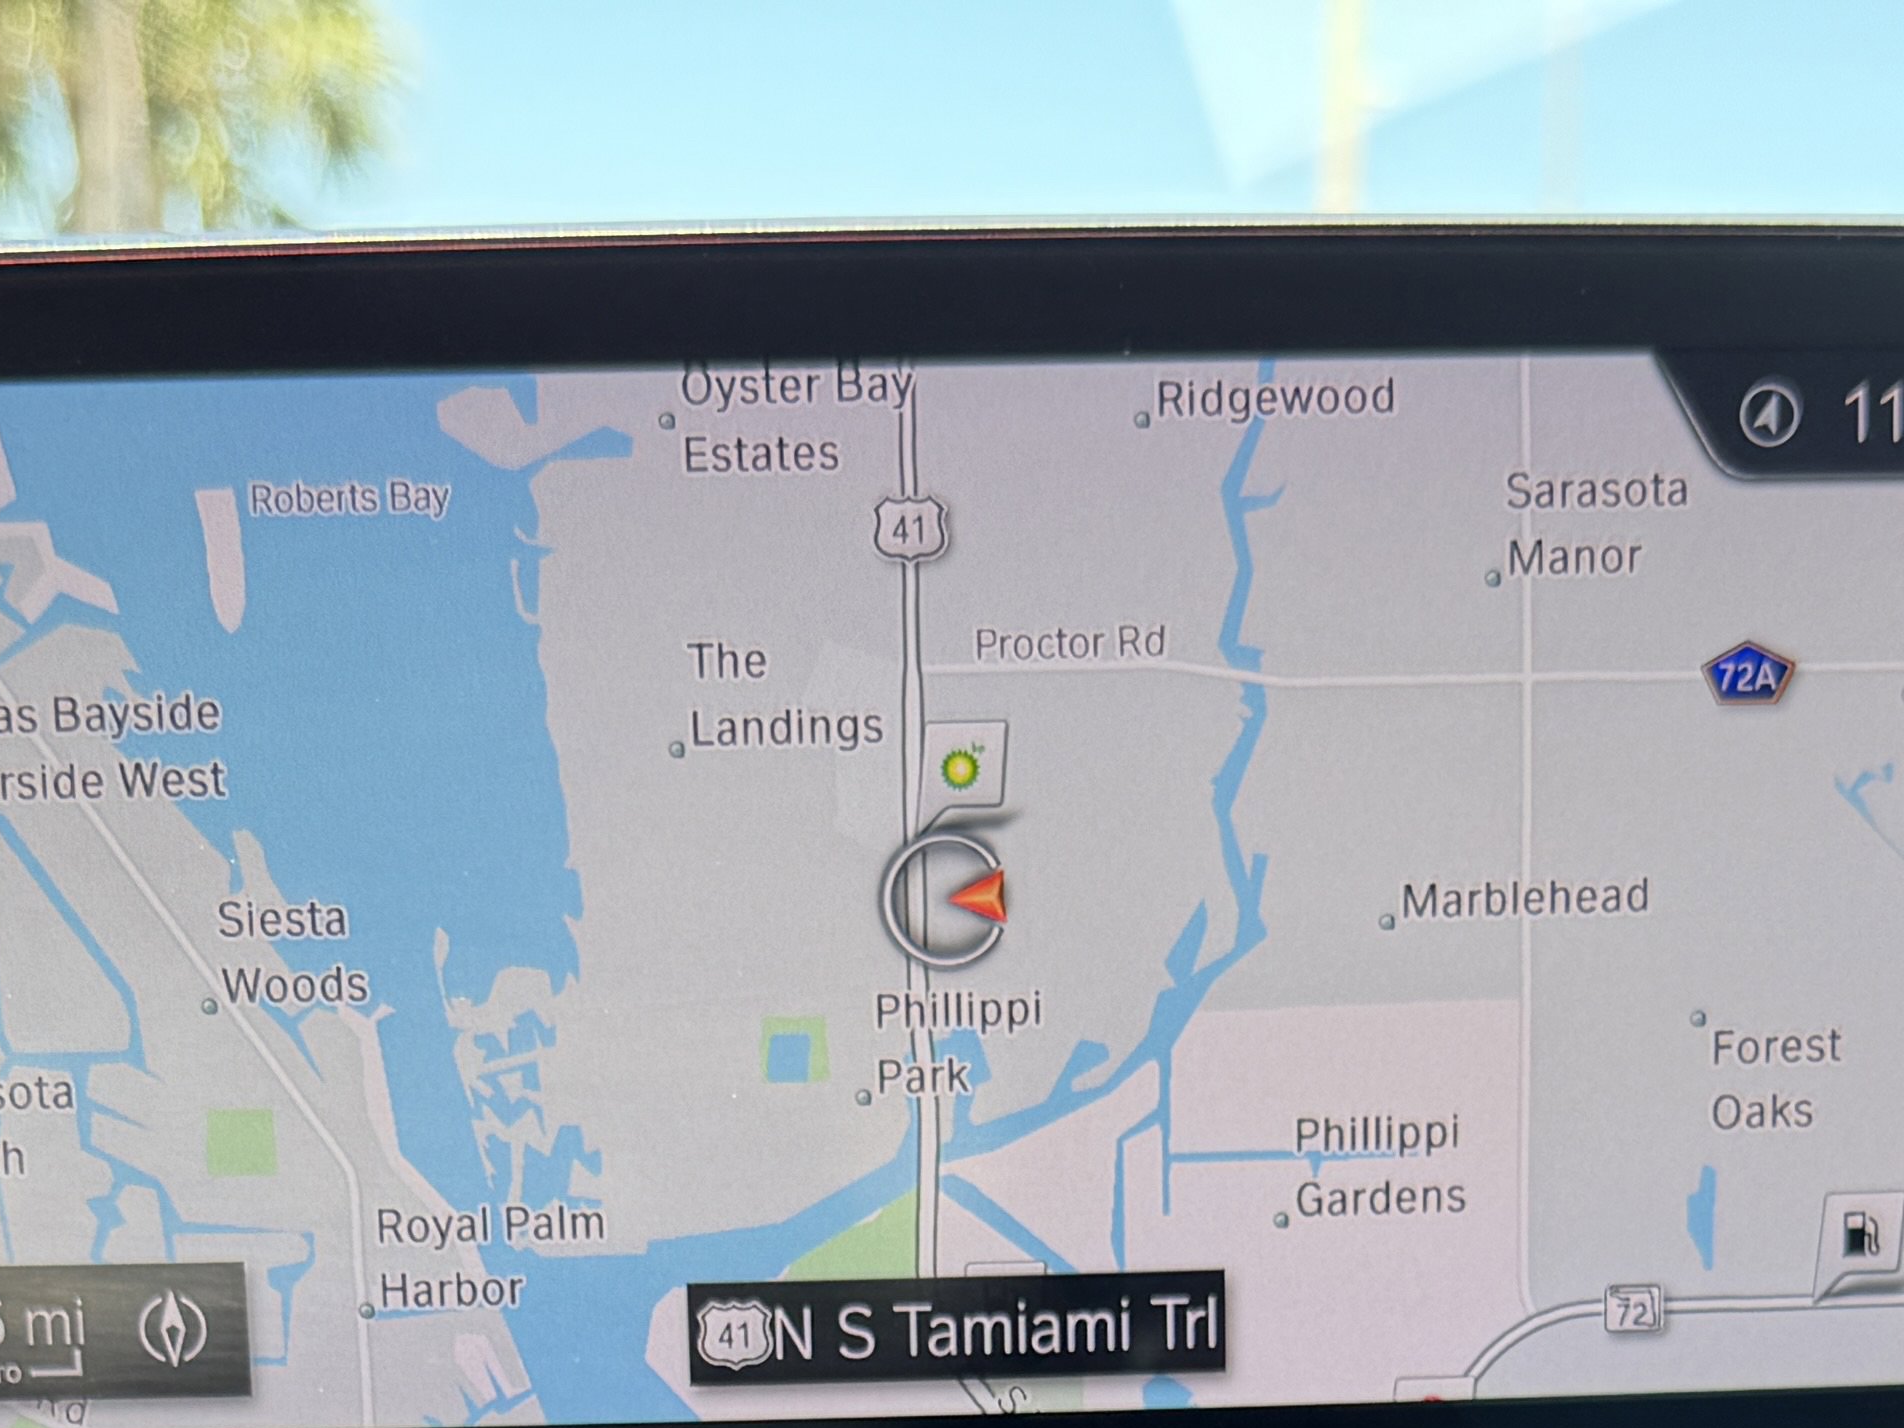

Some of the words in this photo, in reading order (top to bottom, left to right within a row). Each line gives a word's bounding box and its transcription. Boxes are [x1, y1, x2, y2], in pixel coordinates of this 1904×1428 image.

[682, 356, 821, 413] Oyster
[837, 356, 913, 410] Bay
[1157, 378, 1396, 423] Ridgewood
[685, 436, 839, 473] Estates
[250, 483, 378, 516] Roberts
[389, 481, 451, 519] Bay
[1506, 471, 1689, 509] Sarasota
[892, 516, 926, 545] 41
[1508, 539, 1642, 576] Manor
[688, 641, 767, 678] The
[976, 629, 1104, 660] Proctor
[1118, 626, 1166, 657] Rd
[1717, 663, 1776, 692] 72A
[52, 694, 221, 737] Bayside
[692, 710, 884, 752] Landings
[118, 760, 227, 798] West
[1402, 878, 1649, 919] Marblehead
[218, 900, 347, 939] Siesta
[222, 966, 369, 1004] Woods
[877, 990, 1043, 1031] Phillippi
[1713, 1027, 1842, 1065] Forest
[878, 1056, 971, 1096] Park
[1712, 1092, 1814, 1130] Oaks
[1296, 1114, 1460, 1156] Phillippi
[1297, 1179, 1467, 1218] Gardens
[377, 1205, 490, 1247] Royal
[505, 1204, 606, 1242] Palm
[380, 1273, 525, 1312] Harbor
[26, 1297, 85, 1346] mi
[718, 1321, 752, 1350] 41
[773, 1308, 813, 1361] N
[838, 1304, 876, 1361] S
[893, 1299, 1130, 1358] Tamiami
[1150, 1295, 1218, 1352] Trl
[1617, 1300, 1648, 1326] 72
